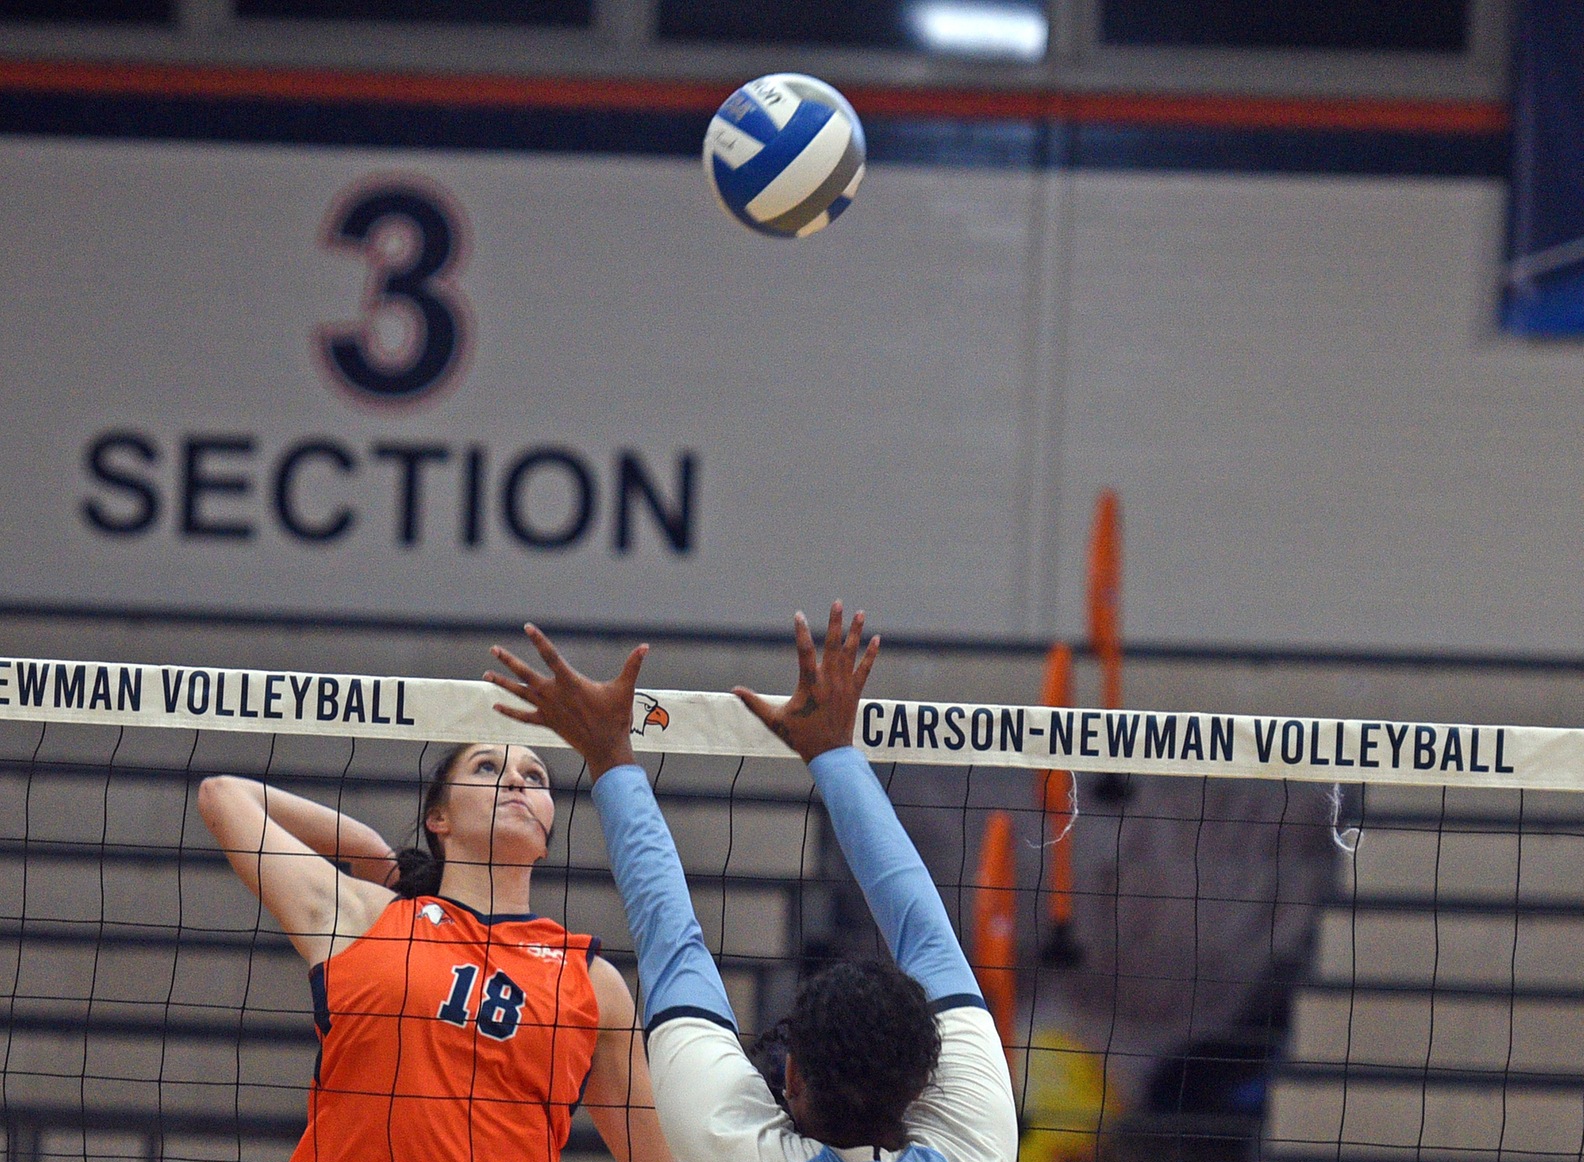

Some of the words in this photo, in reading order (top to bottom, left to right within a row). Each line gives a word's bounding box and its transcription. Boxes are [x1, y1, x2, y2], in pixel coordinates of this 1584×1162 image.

[316, 173, 473, 409] 3
[83, 429, 697, 556] SECTION
[162, 669, 415, 726] VOLLEYBALL
[862, 703, 1235, 762] CARSON-NEWMAN
[1254, 719, 1514, 773] VOLLEYBALL
[438, 963, 526, 1041] 18
